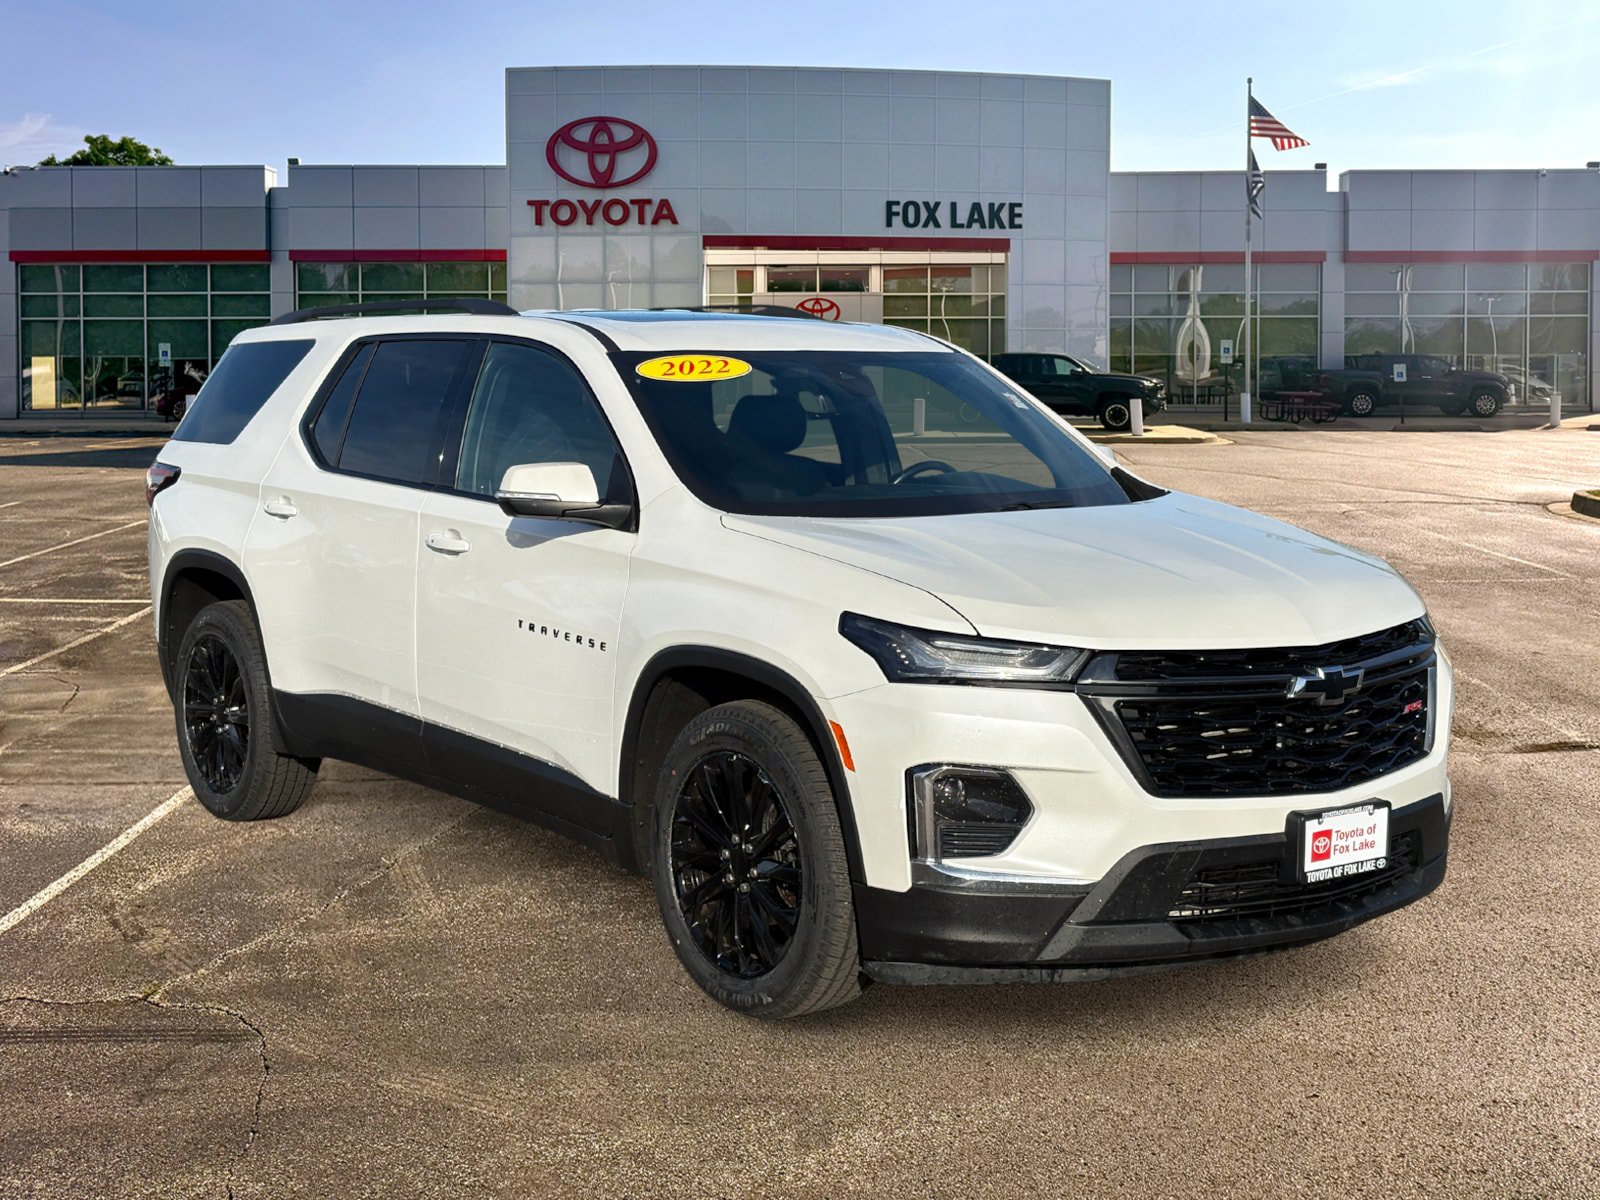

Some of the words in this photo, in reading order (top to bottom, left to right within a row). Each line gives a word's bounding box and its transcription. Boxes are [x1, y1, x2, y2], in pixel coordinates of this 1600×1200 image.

[527, 198, 679, 226] TOYOTA
[885, 200, 942, 228] FOX
[950, 201, 1023, 229] LAKE
[661, 359, 730, 377] 2022
[517, 619, 607, 652] TRAVERSE
[1334, 826, 1364, 842] Toyota
[1366, 823, 1377, 835] of
[1333, 843, 1350, 855] Fox
[1352, 838, 1376, 852] Lake
[1306, 868, 1333, 883] TOYOTA
[1333, 866, 1342, 877] OF
[1343, 864, 1358, 876] FOX
[1358, 860, 1377, 874] LAKE
